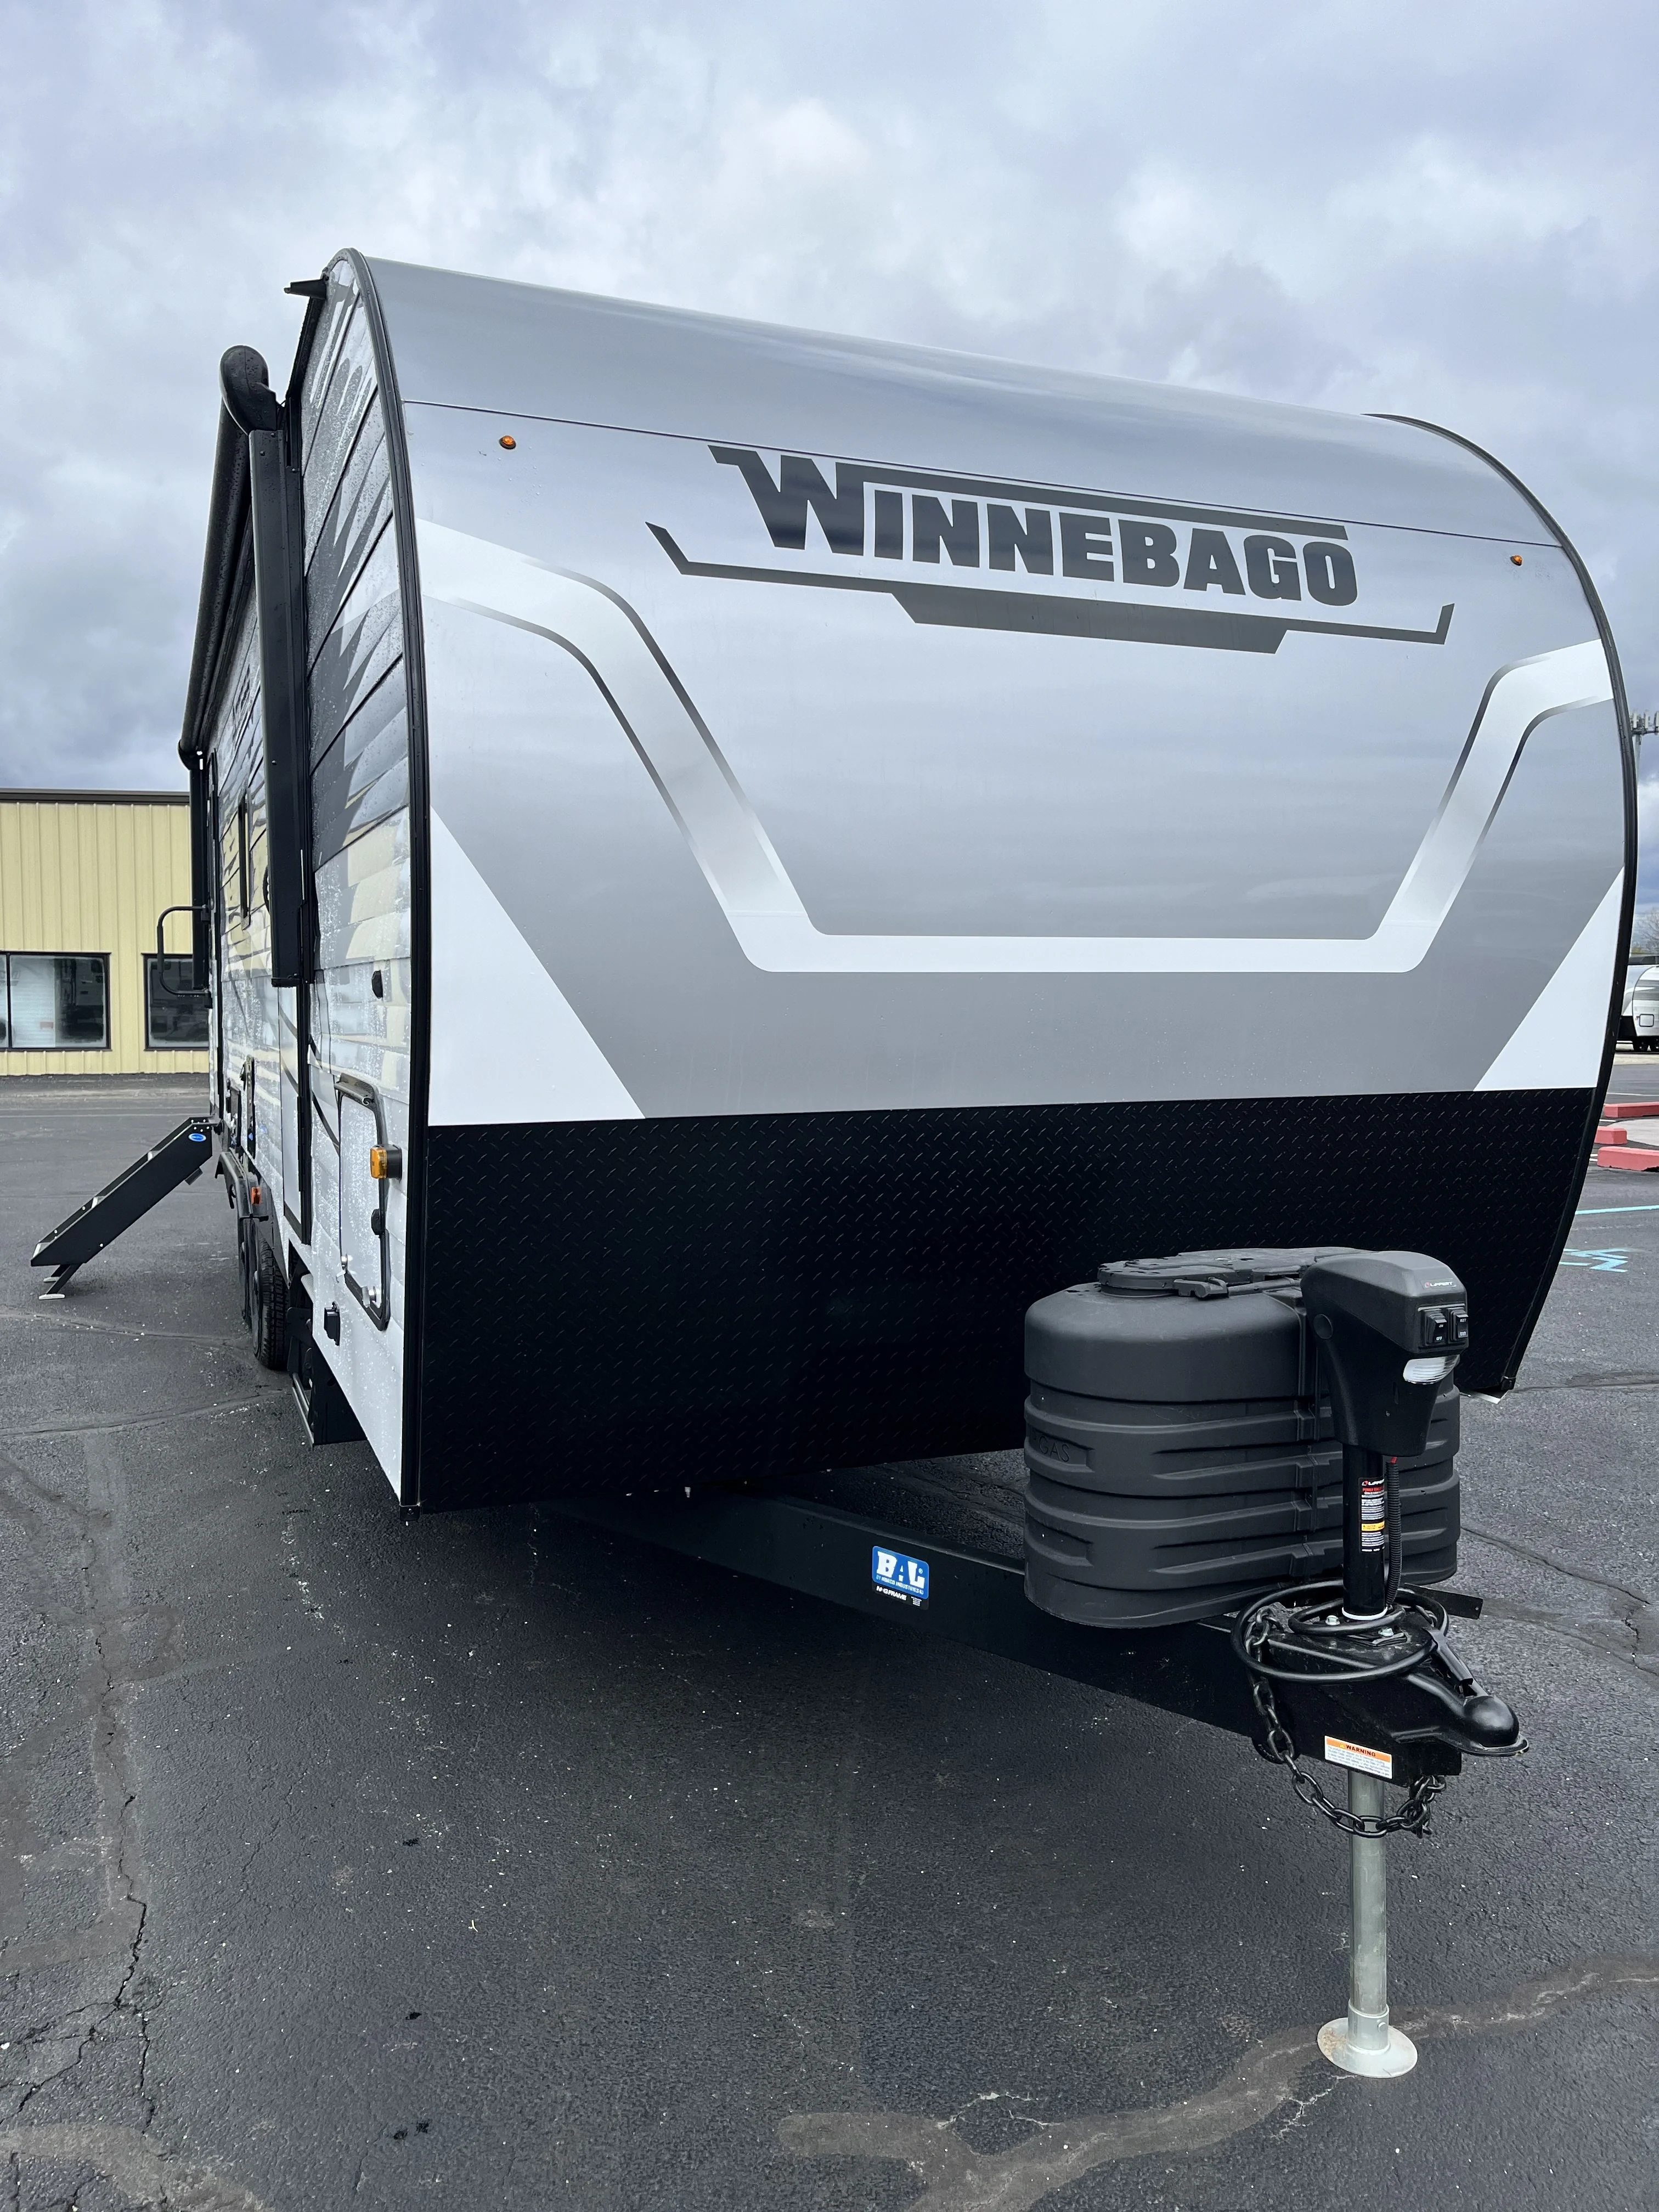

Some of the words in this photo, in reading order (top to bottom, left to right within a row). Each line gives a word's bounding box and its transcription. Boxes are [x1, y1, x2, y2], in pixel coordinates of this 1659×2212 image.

[708, 445, 1357, 606] WINNEBAGO
[1039, 1435, 1070, 1462] GAS
[895, 1581, 919, 1594] INDUSTRIES
[1345, 1744, 1376, 1757] WARNING
